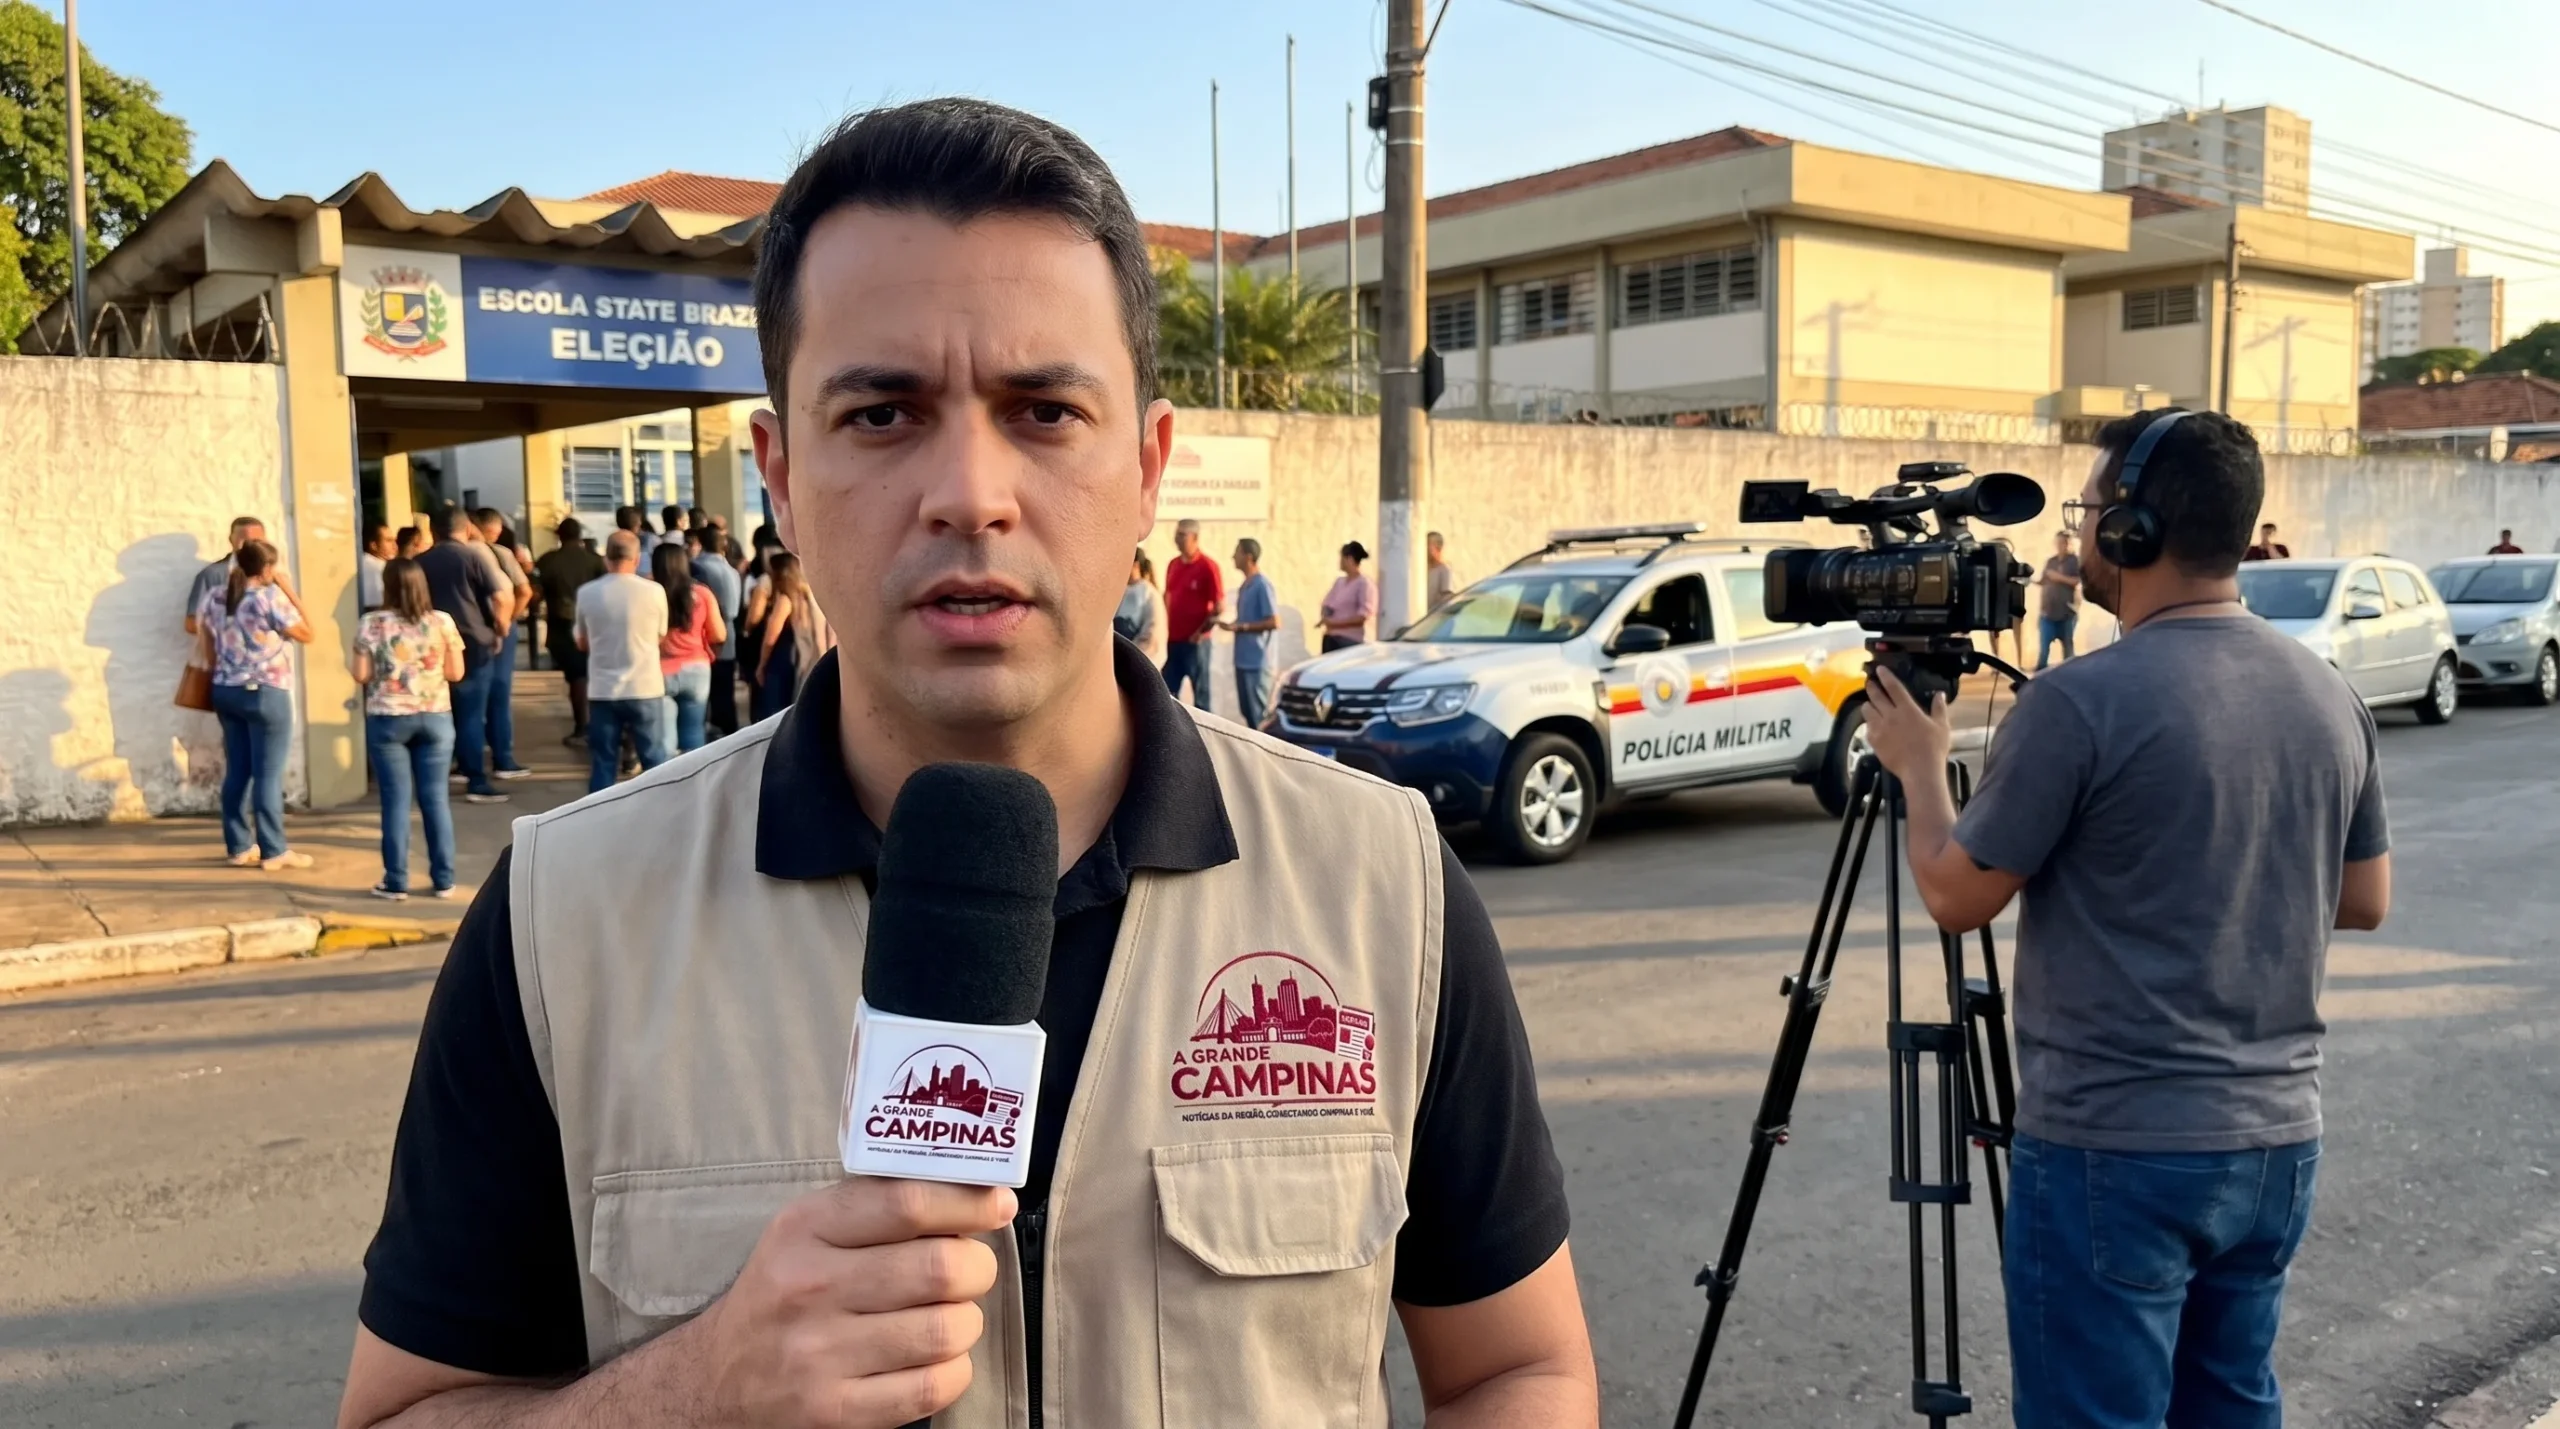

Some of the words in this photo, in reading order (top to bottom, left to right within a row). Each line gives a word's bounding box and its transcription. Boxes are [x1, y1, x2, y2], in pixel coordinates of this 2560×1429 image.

[478, 286, 590, 317] ESCOLA
[595, 295, 677, 323] STATE
[551, 327, 724, 371] ELEÇIÃO
[1622, 730, 1706, 764] POLÍCIA
[1713, 717, 1793, 750] MILITAR
[1172, 1050, 1188, 1065] A
[1192, 1046, 1271, 1063] GRANDE
[1171, 1061, 1377, 1100] CAMPINAS
[870, 1104, 880, 1113] A
[883, 1105, 935, 1118] GRANDE
[1221, 1111, 1234, 1120] DA
[865, 1115, 1016, 1149] CAMPINAS
